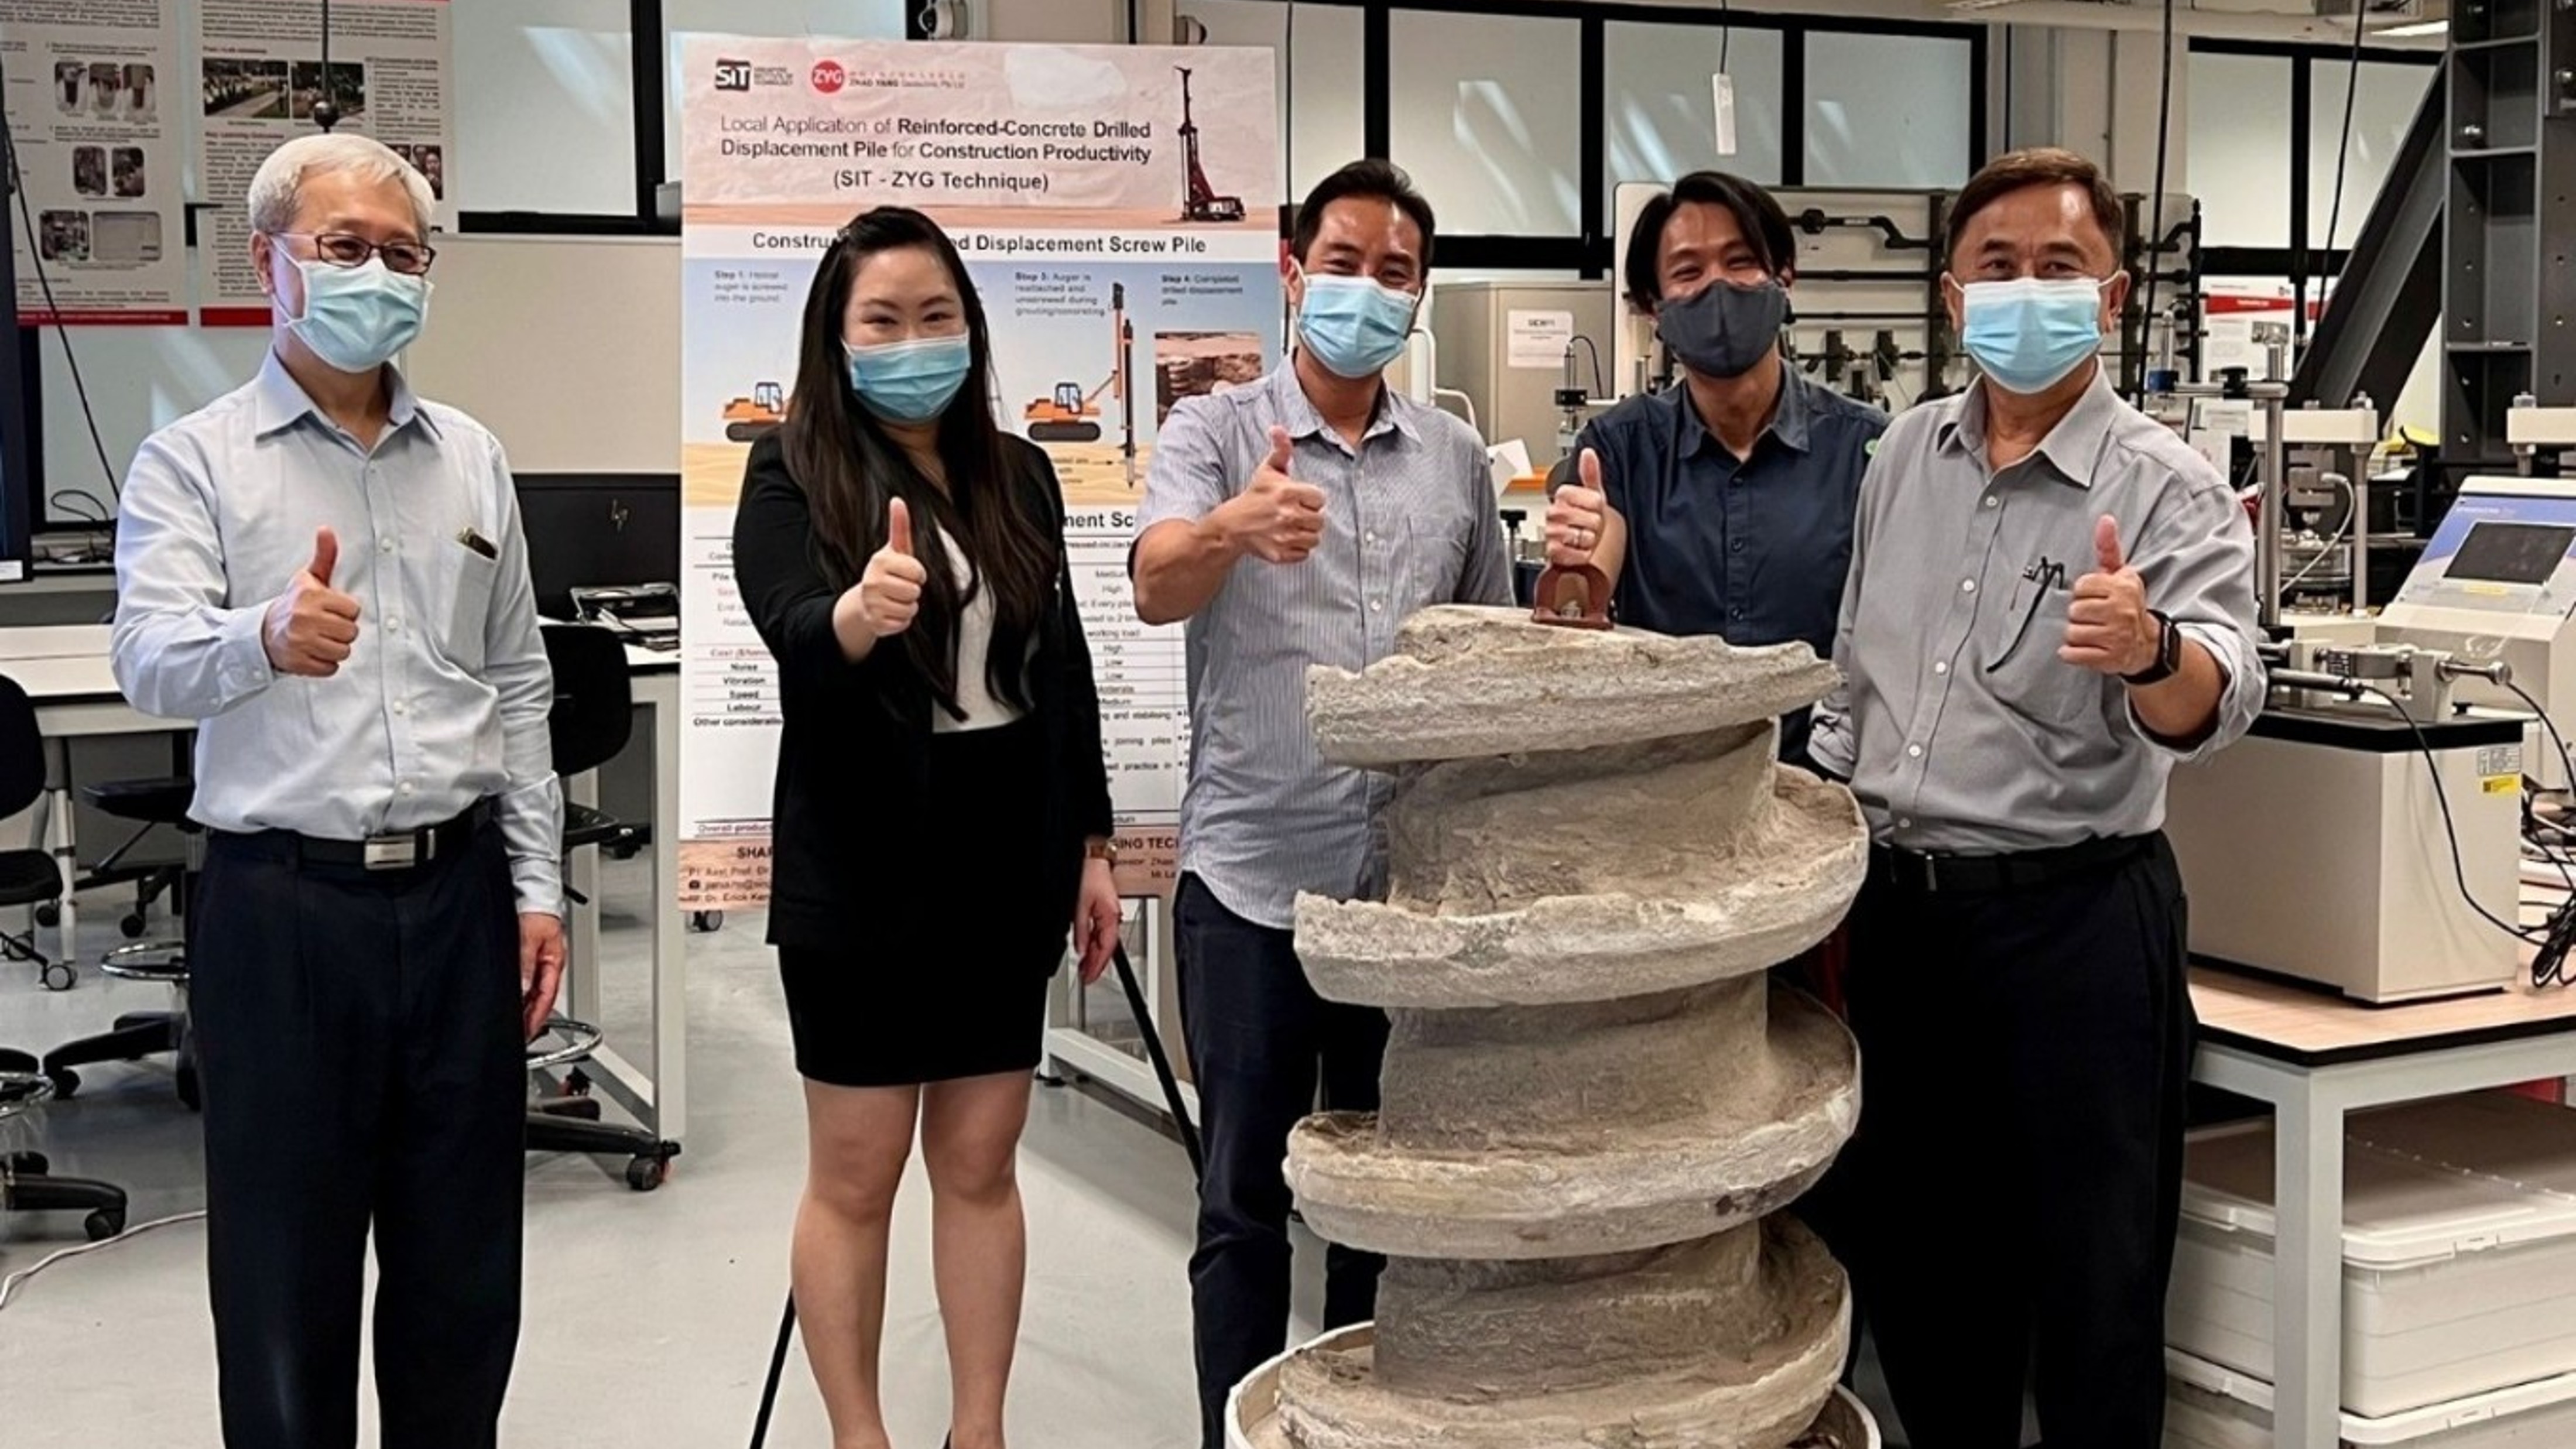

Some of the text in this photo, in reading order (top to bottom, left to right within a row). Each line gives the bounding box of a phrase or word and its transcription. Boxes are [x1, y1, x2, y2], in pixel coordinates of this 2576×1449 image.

[813, 69, 842, 84] ZYG
[721, 117, 1151, 138] Local Application of Reinforced-Concrete Drilled
[721, 139, 1152, 165] Displacement Pile for Construction Productivity
[834, 170, 872, 190] (SIT
[892, 171, 934, 188] ZYG
[940, 172, 1049, 193] Technique)
[753, 233, 830, 249] Constru
[976, 234, 1104, 254] Displacement
[1109, 237, 1166, 252] Screw
[1172, 237, 1207, 252] Pile
[1015, 272, 1038, 282] Step
[1162, 275, 1182, 284] Step
[1087, 630, 1119, 640] working
